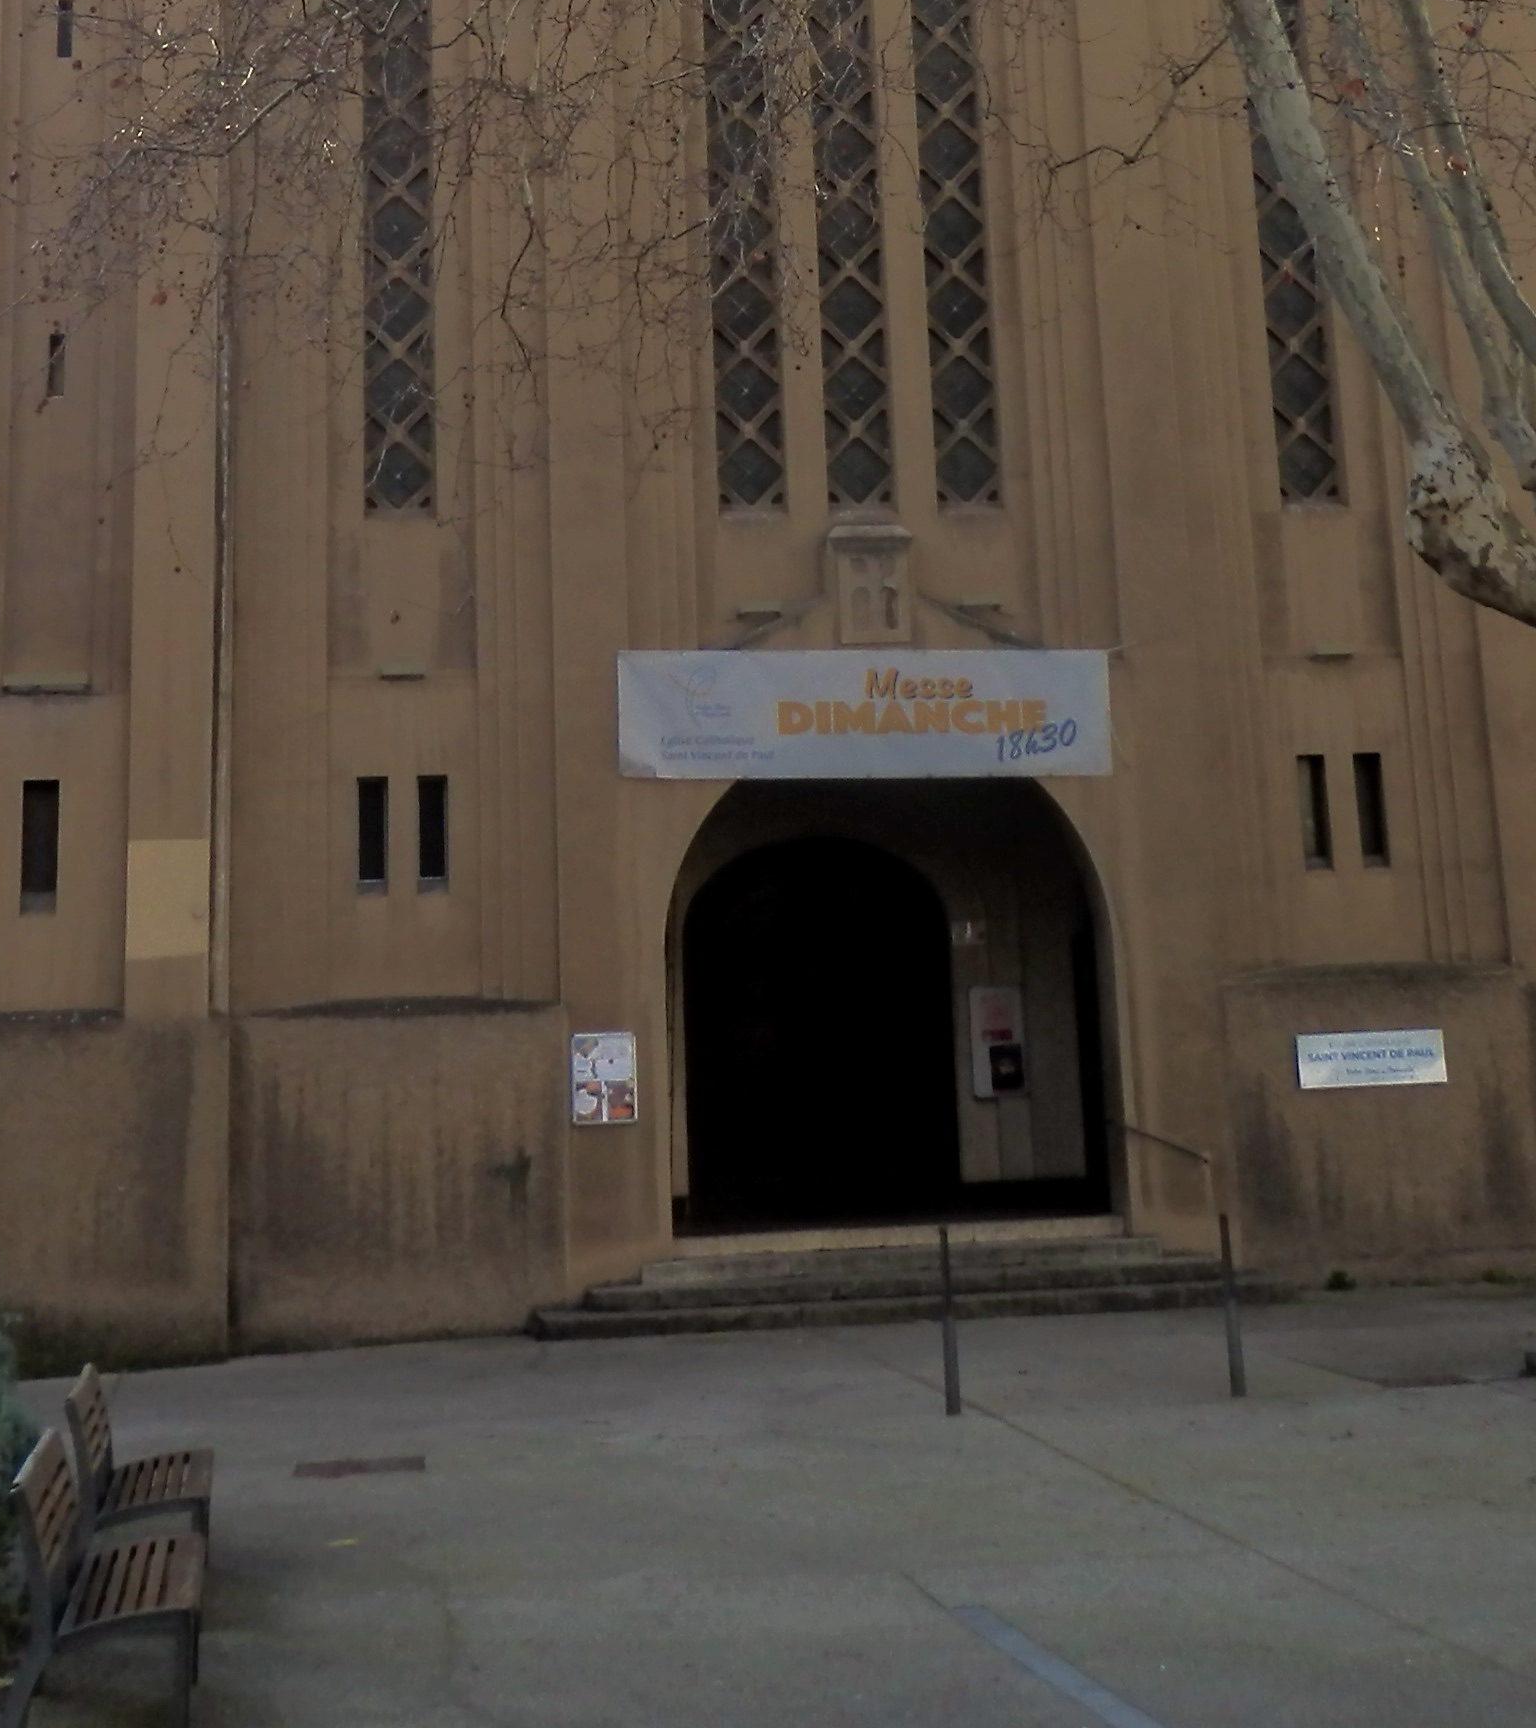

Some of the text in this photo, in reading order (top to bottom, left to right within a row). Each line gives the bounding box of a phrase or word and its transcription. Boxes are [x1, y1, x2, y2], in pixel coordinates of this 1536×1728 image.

[865, 666, 974, 700] Messe
[777, 699, 1047, 736] DIMANCHE
[661, 749, 775, 760] Saint Vincent de Paul
[995, 718, 1077, 762] 18h30
[1307, 1047, 1435, 1062] SAINT VINCENT DE PAUL
